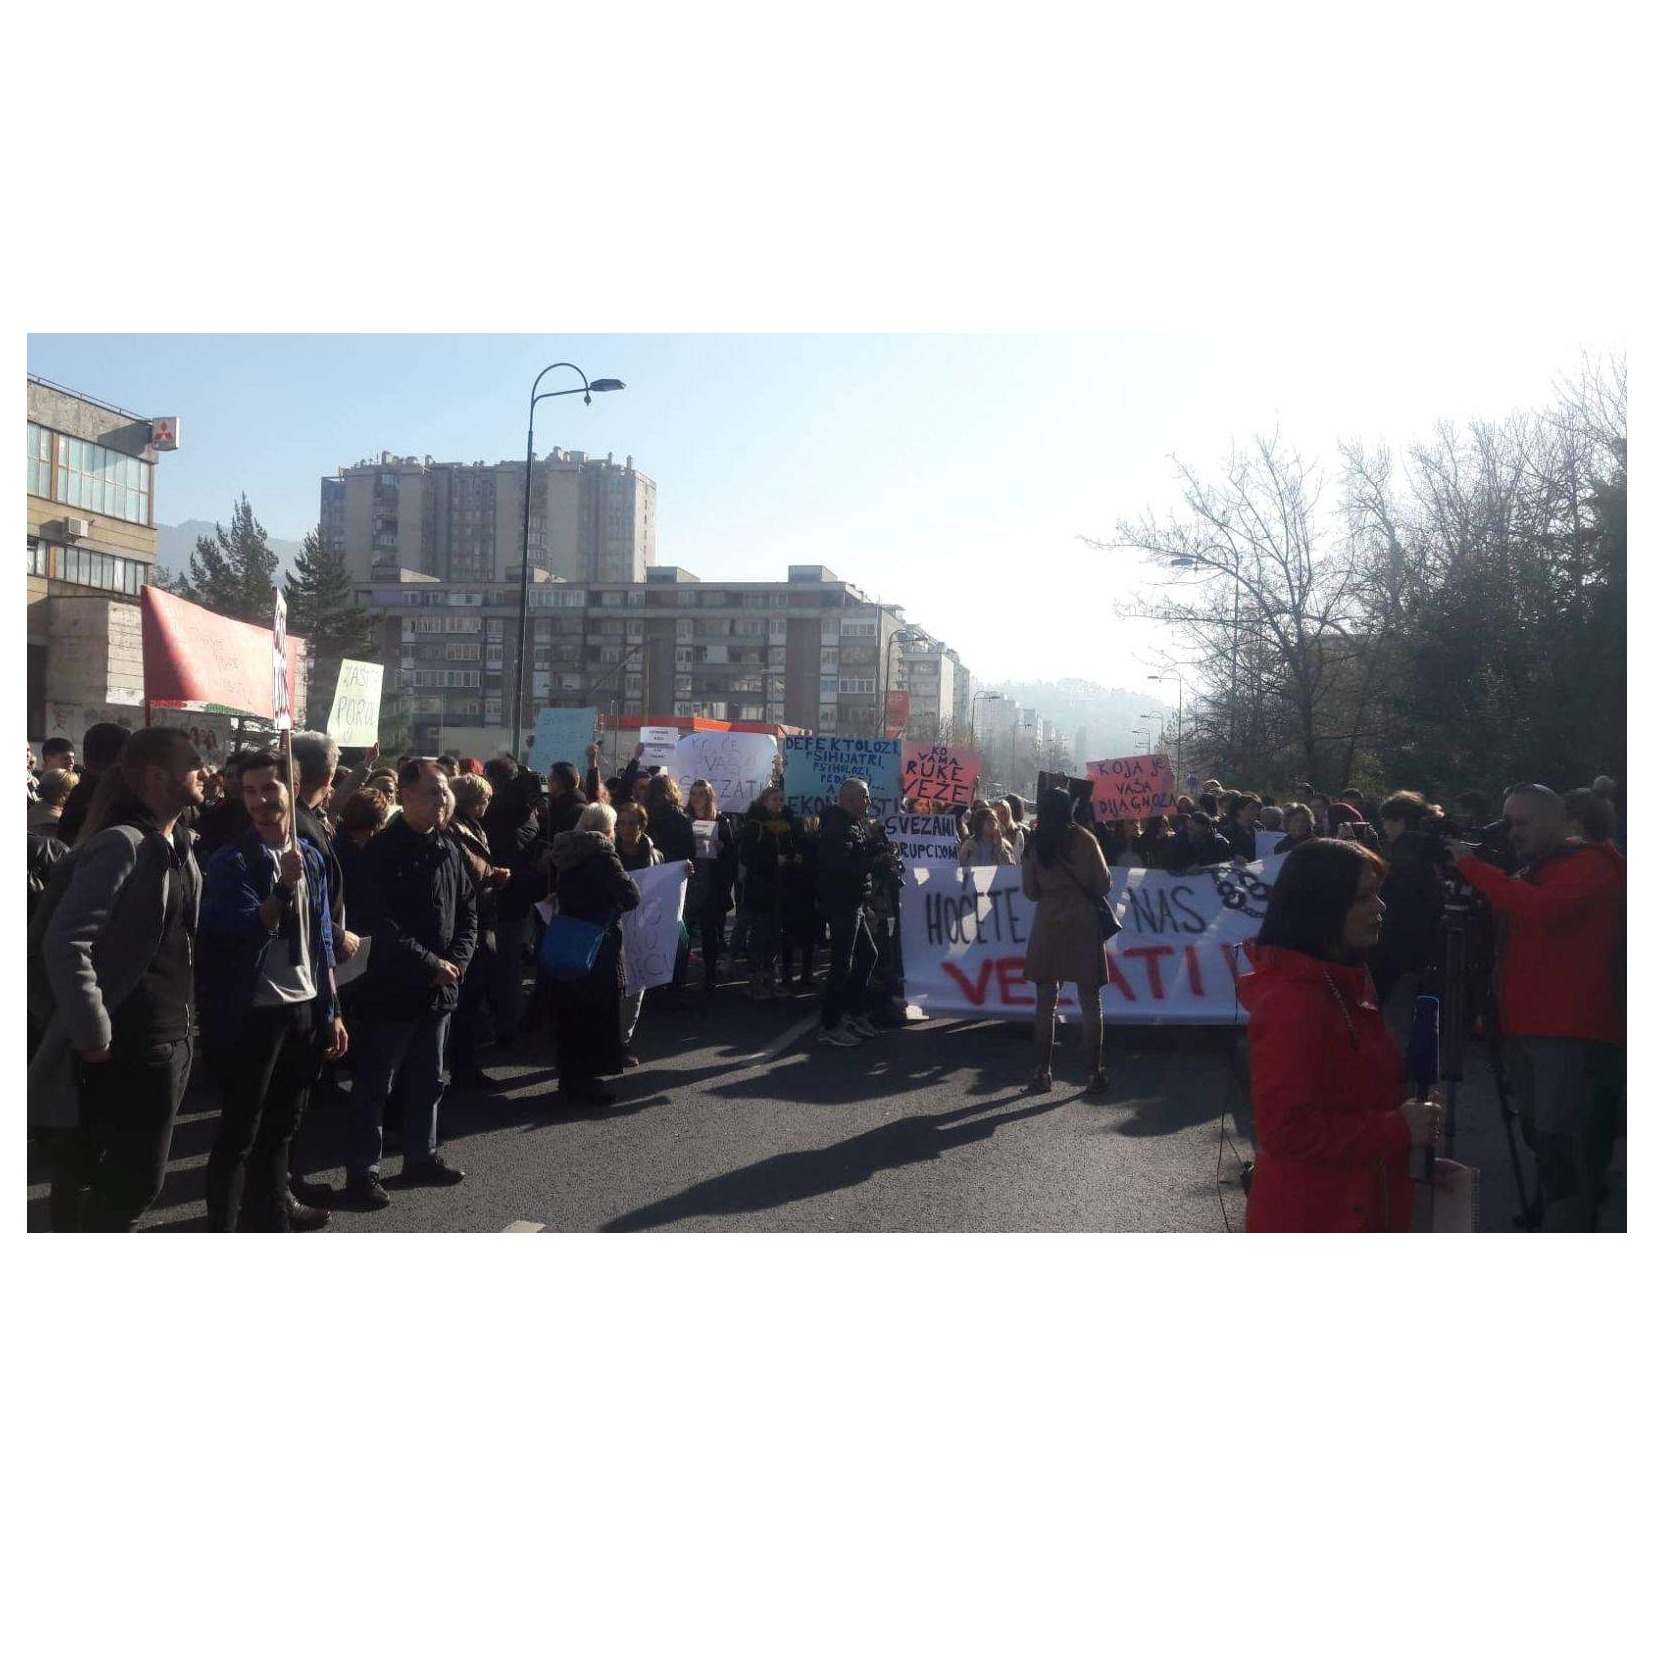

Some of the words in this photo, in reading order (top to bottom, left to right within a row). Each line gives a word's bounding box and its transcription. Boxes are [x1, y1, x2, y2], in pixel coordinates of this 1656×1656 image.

[918, 752, 958, 766] VAMA
[931, 747, 947, 756] KO
[906, 760, 964, 783] RUKE
[1098, 760, 1143, 778] KOJA
[1099, 792, 1178, 817] DIJAGNOZA
[1127, 885, 1207, 934] NAS
